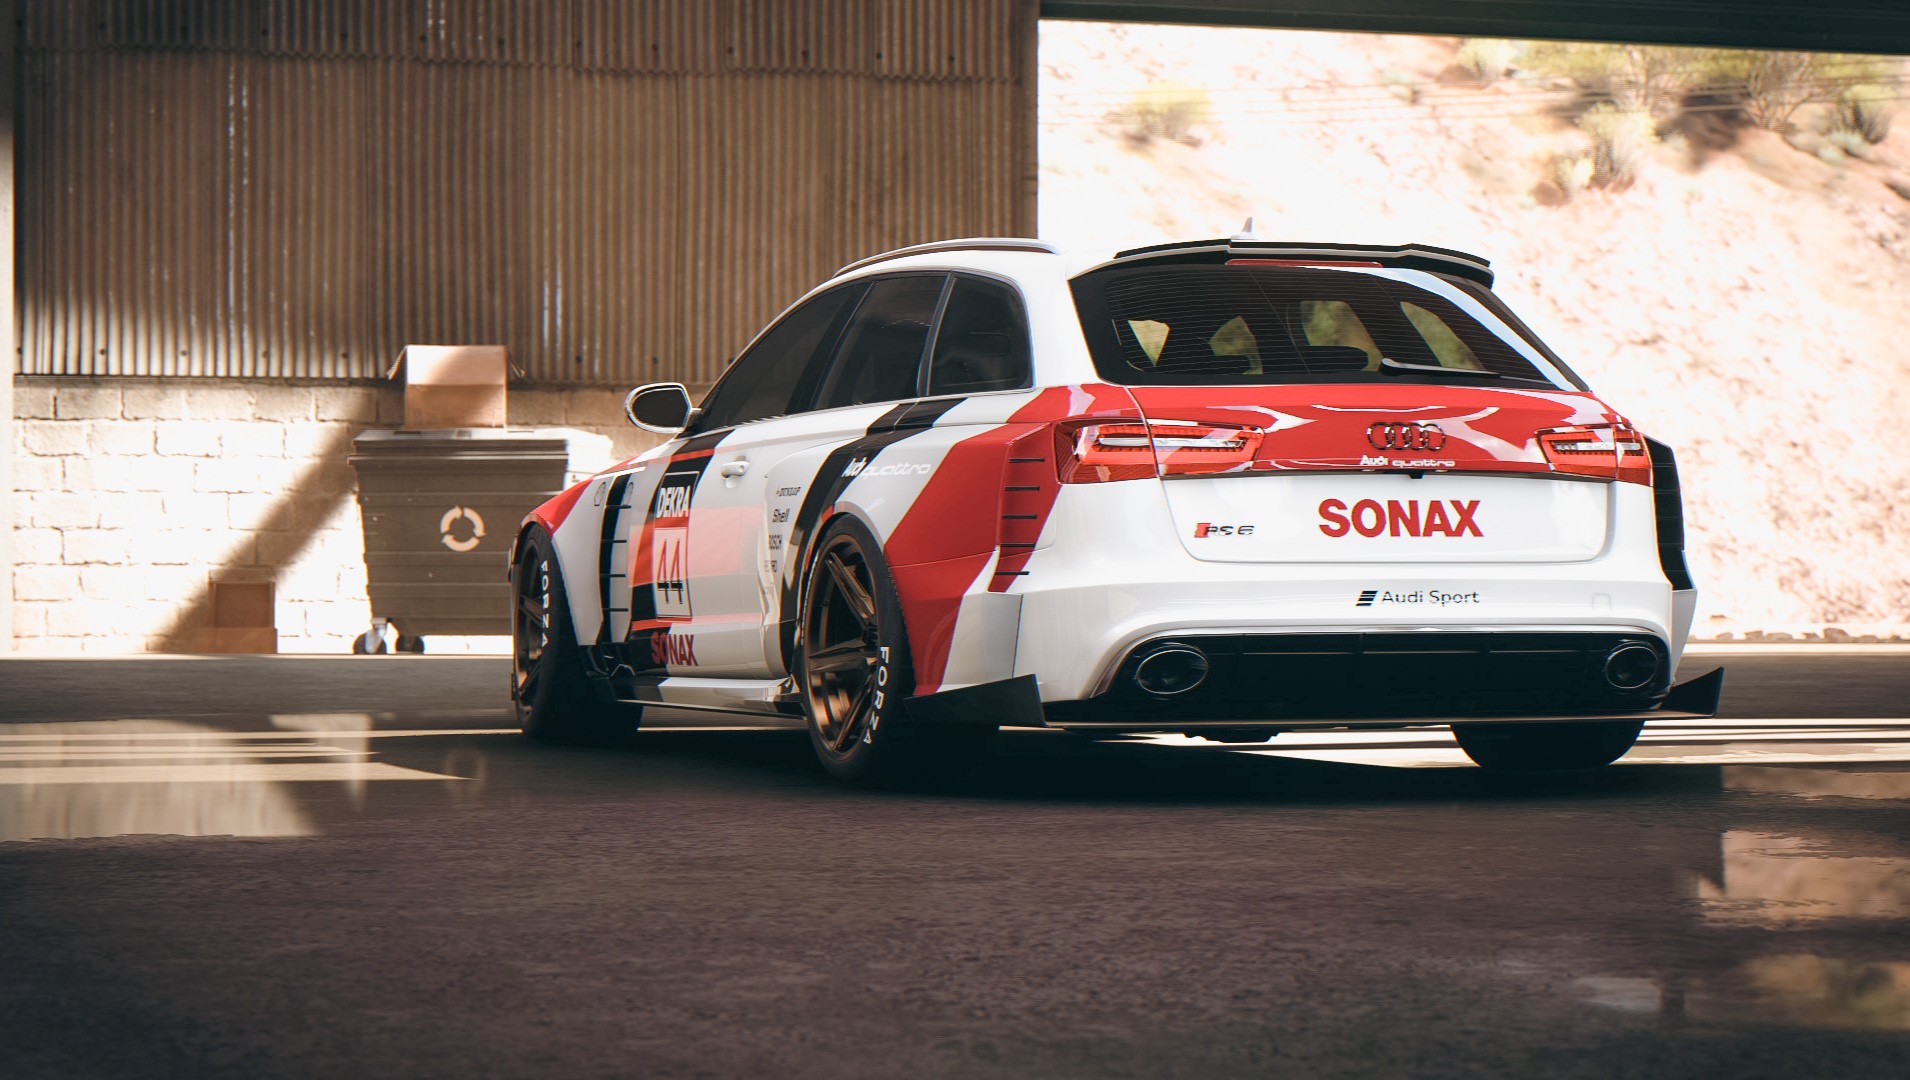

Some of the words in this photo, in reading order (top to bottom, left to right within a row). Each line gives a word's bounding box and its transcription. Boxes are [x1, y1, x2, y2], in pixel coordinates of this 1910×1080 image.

[862, 462, 931, 479] quattro
[1360, 454, 1388, 466] Audi
[1392, 459, 1455, 468] quattro
[656, 485, 691, 518] DEKRA
[772, 508, 790, 522] Shell
[1318, 498, 1484, 537] SONAX
[657, 538, 683, 604] 44
[1382, 591, 1423, 603] Audi
[1428, 590, 1480, 607] Sport
[651, 631, 699, 666] SONAX
[862, 646, 890, 744] FORZA
